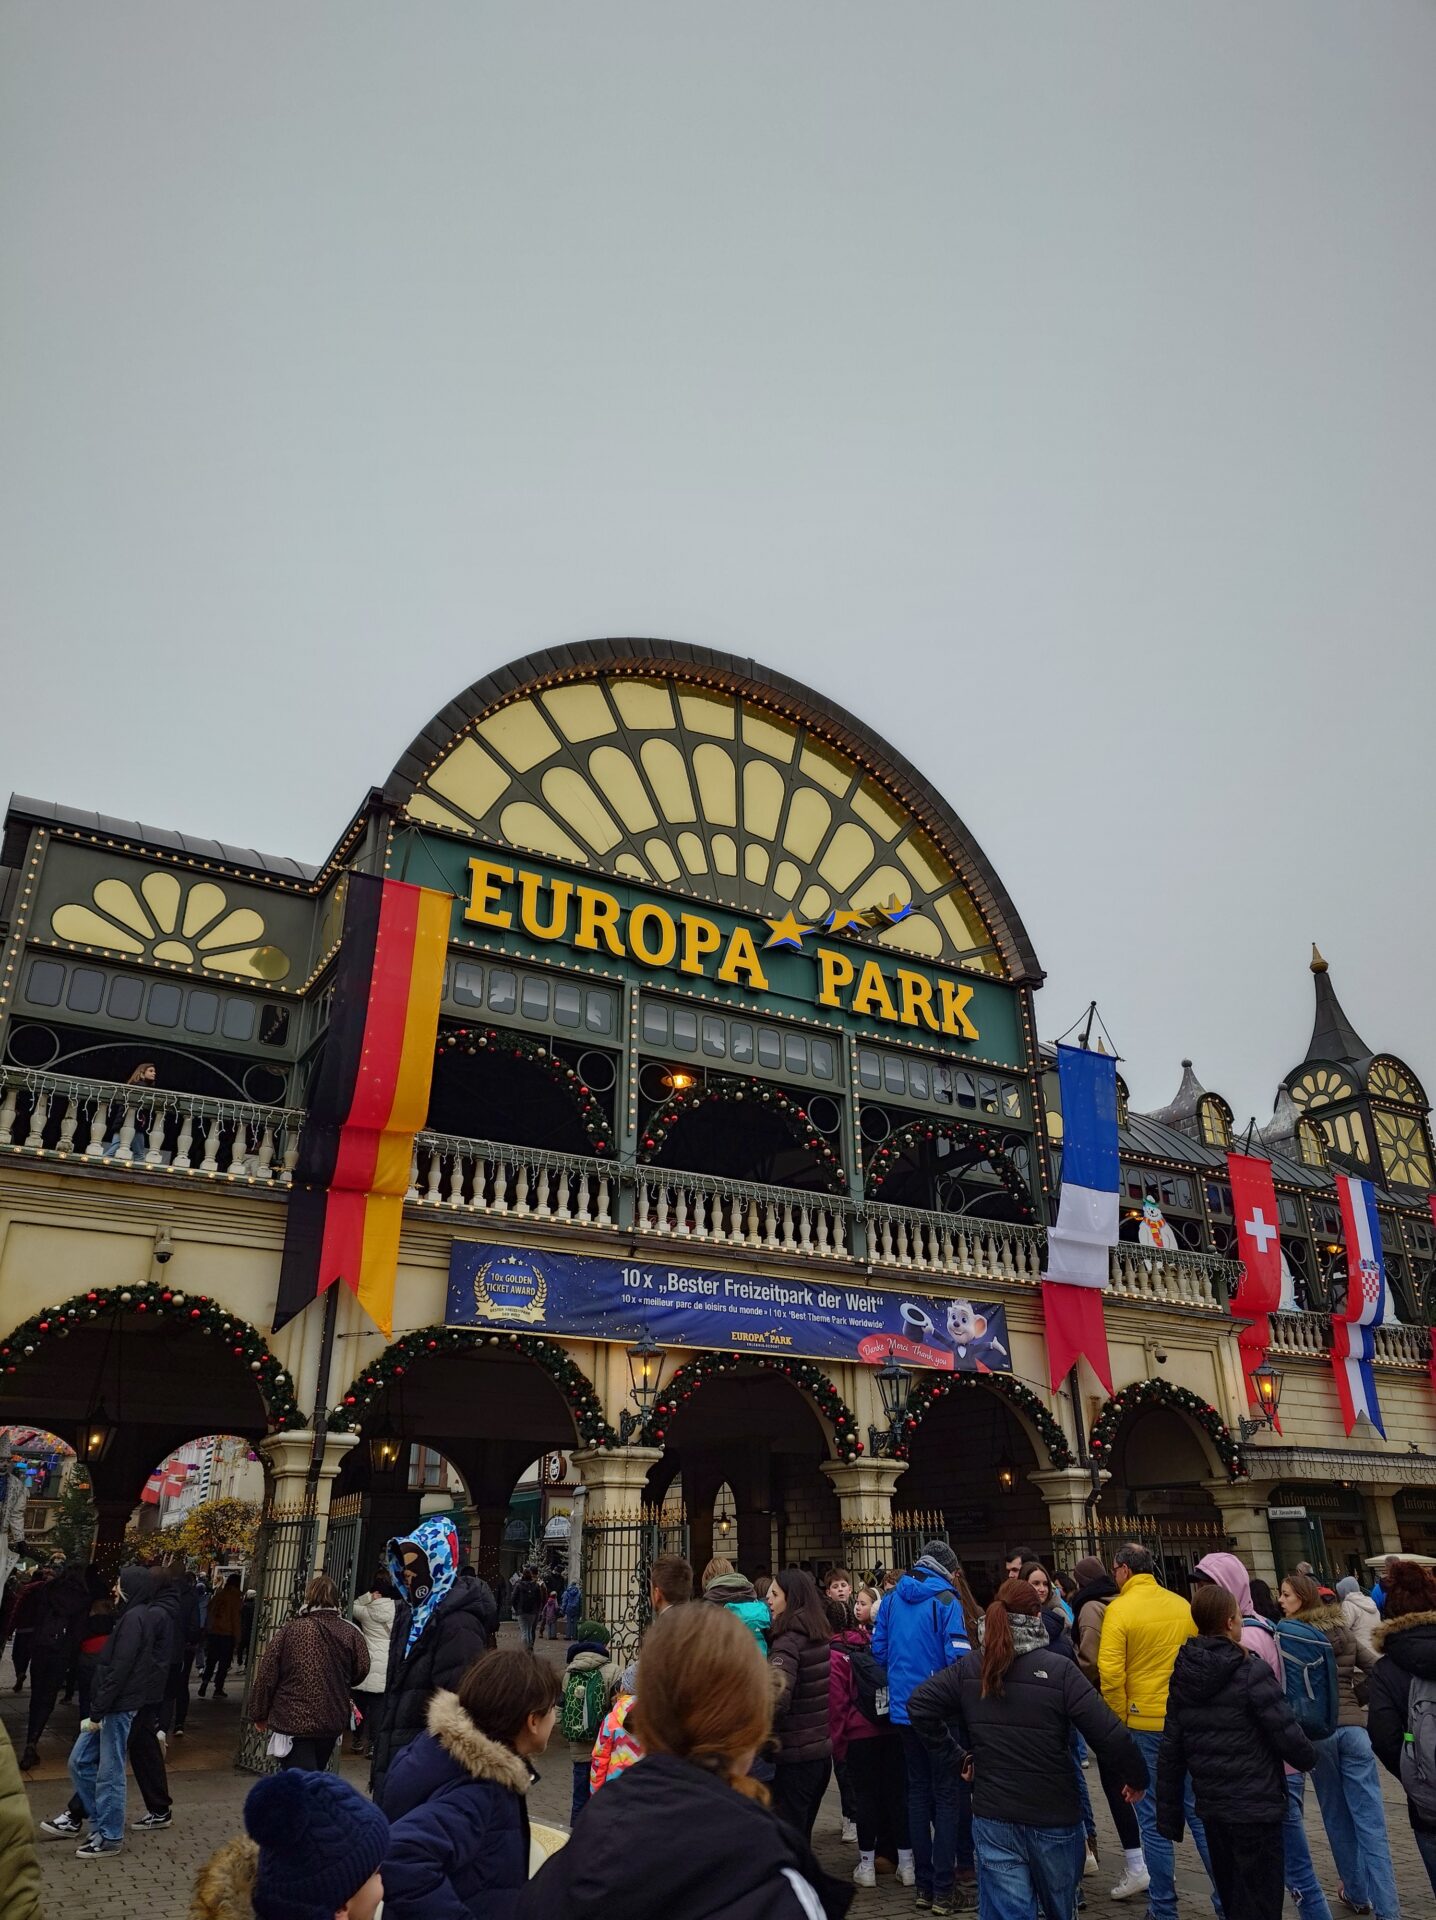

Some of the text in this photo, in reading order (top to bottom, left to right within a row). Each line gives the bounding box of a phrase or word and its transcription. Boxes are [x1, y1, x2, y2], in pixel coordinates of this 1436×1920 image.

[463, 856, 980, 1042] EUROPA PARK
[486, 1282, 536, 1296] TICKET AWARD
[505, 1273, 533, 1285] GOLDEN
[724, 1278, 814, 1307] Freizeitpark
[817, 1290, 842, 1309] der
[675, 1299, 692, 1310] parc
[693, 1301, 703, 1310] de
[704, 1301, 727, 1312] loisirs
[728, 1303, 738, 1313] du
[807, 1312, 831, 1323] Theme
[831, 1315, 848, 1325] Park
[731, 1331, 793, 1345] EUROPA PARK
[862, 1337, 947, 1367] Danke Merci Thank you
[1279, 1491, 1341, 1507] Information
